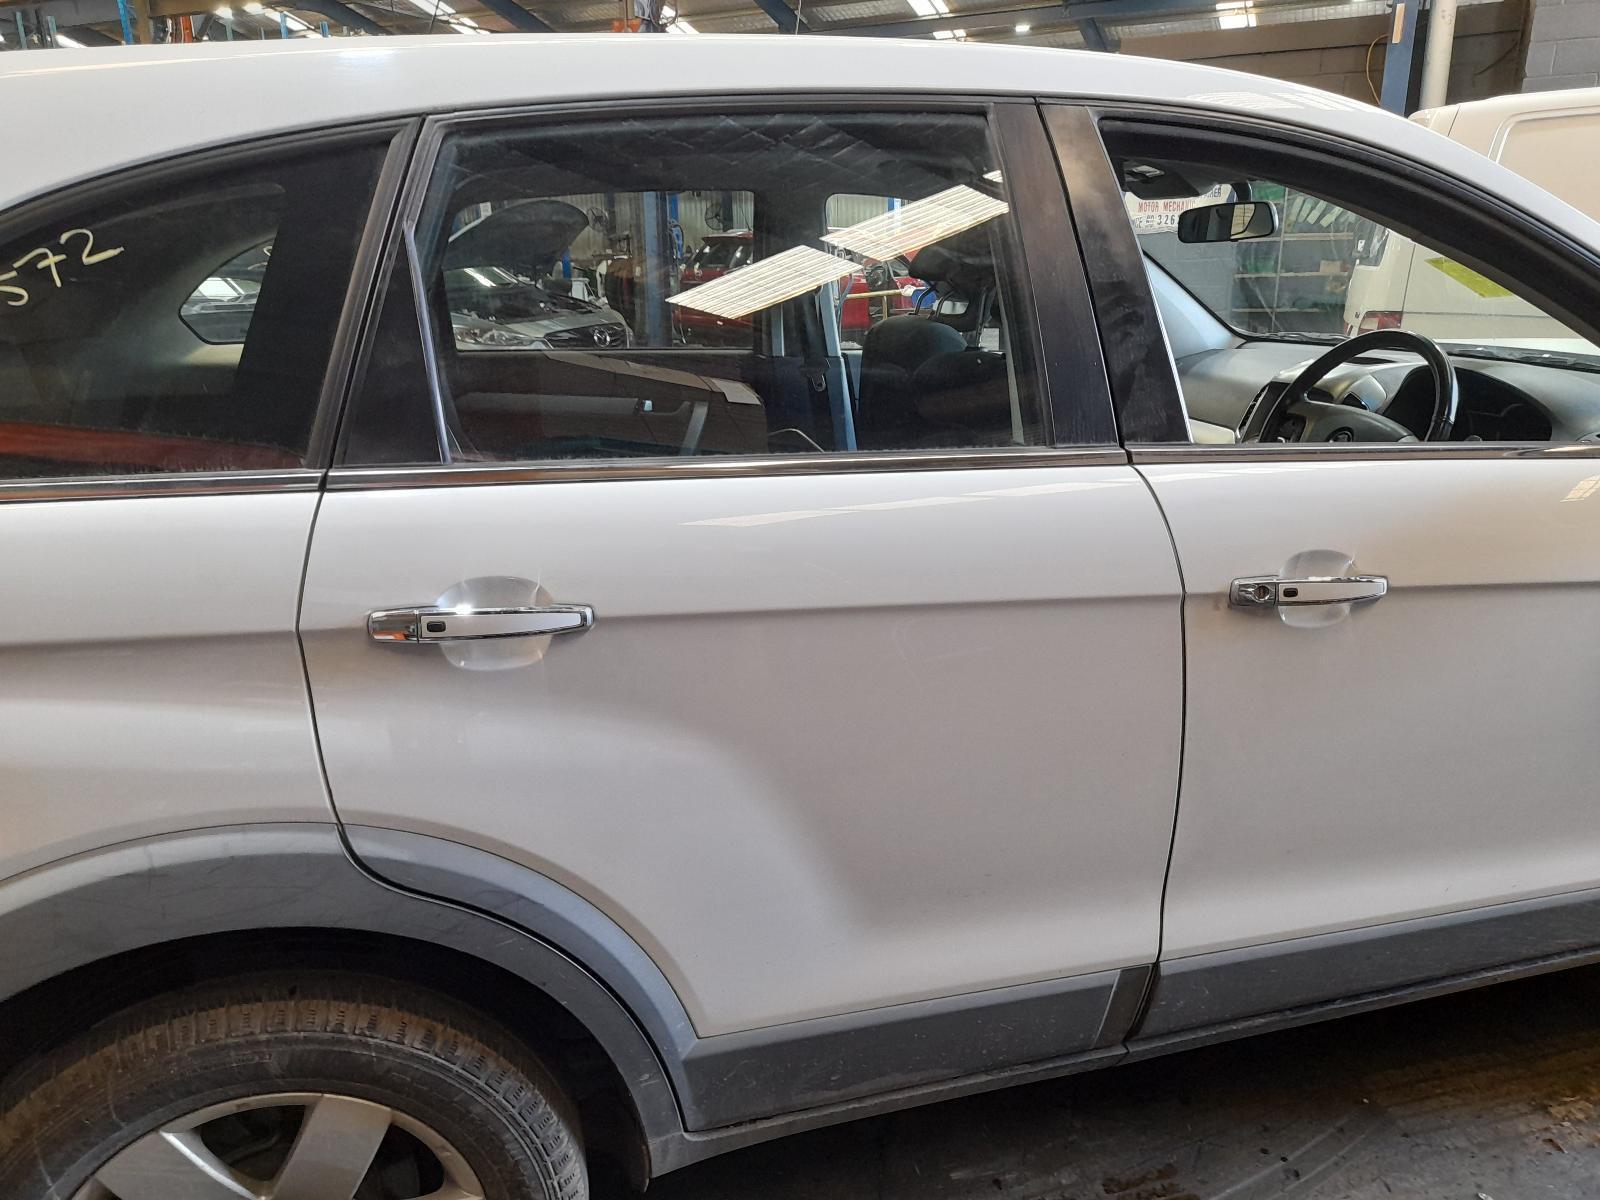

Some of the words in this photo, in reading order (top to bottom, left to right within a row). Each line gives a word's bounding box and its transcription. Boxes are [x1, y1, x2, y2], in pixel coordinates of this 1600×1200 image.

[1138, 201, 1159, 213] MOTOR
[1163, 200, 1196, 212] MECHANIC
[1157, 214, 1180, 225] 326
[0, 229, 124, 306] 572
